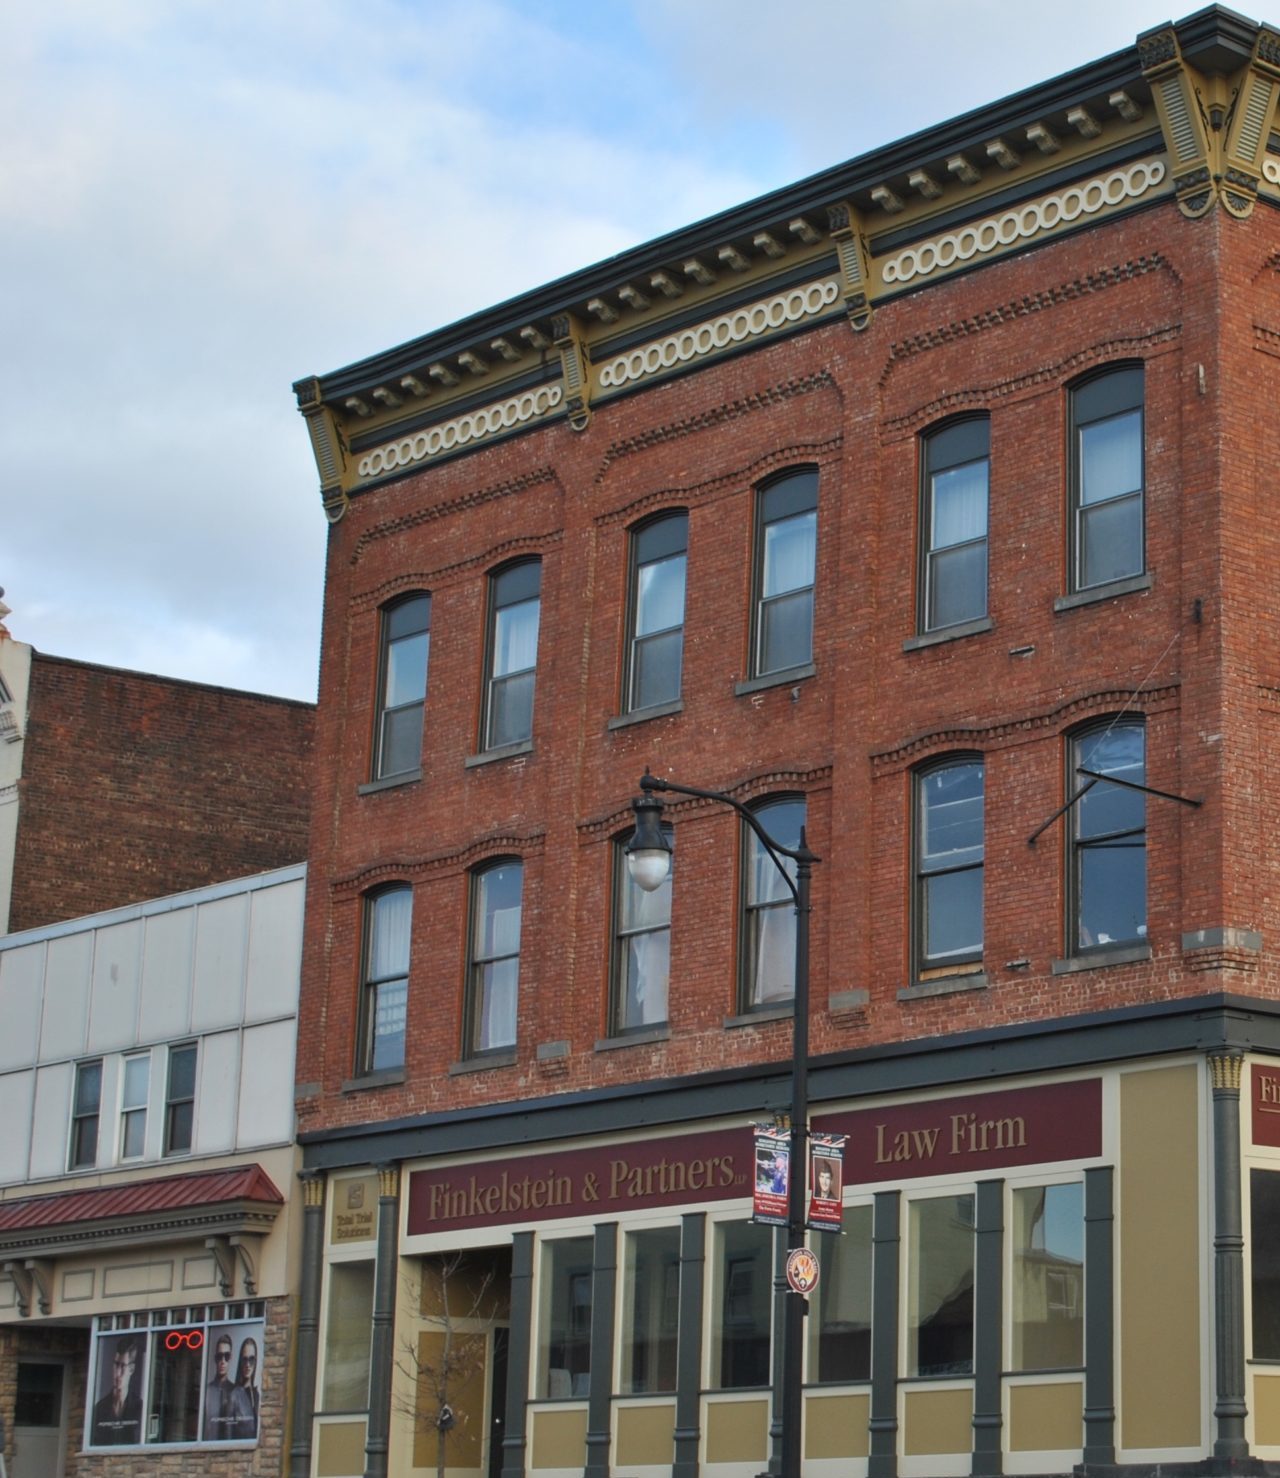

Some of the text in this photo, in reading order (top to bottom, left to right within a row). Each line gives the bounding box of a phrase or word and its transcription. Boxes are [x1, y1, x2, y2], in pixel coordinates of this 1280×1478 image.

[427, 1169, 573, 1222] Finkelstein
[581, 1171, 600, 1202] &
[607, 1155, 735, 1199] Partners
[874, 1124, 941, 1164] Law
[949, 1112, 1028, 1155] Firm
